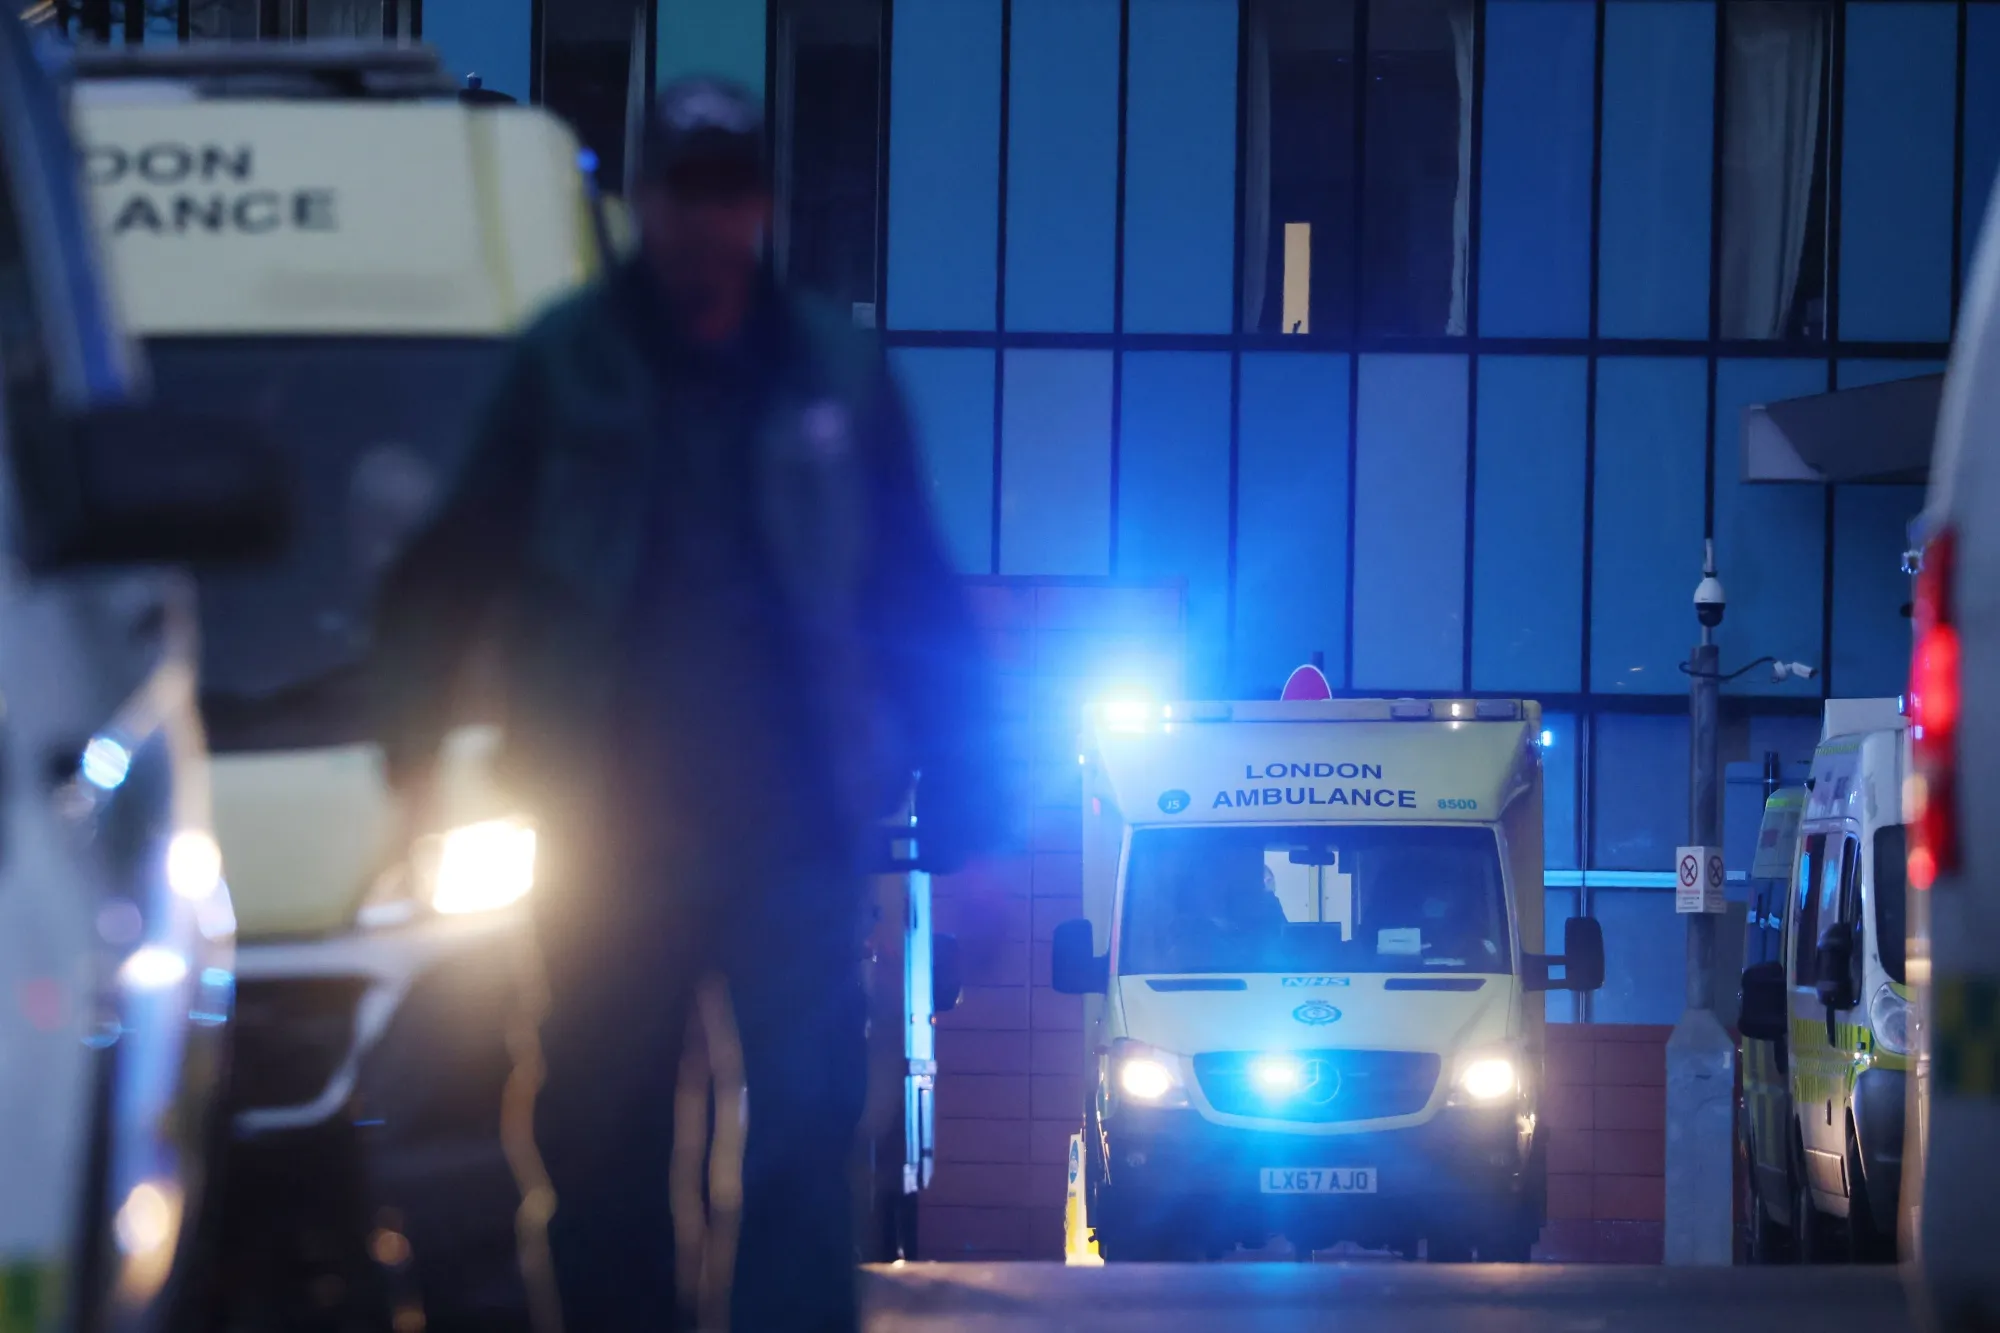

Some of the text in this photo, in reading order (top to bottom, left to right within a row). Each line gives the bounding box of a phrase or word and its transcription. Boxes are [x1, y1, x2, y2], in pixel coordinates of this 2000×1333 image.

[112, 188, 339, 236] ANCE
[1246, 763, 1382, 780] LONDON
[1212, 787, 1417, 808] AMBULANCE
[1437, 799, 1477, 810] 8500
[1284, 977, 1347, 987] NHS
[1269, 1171, 1322, 1190] LX67
